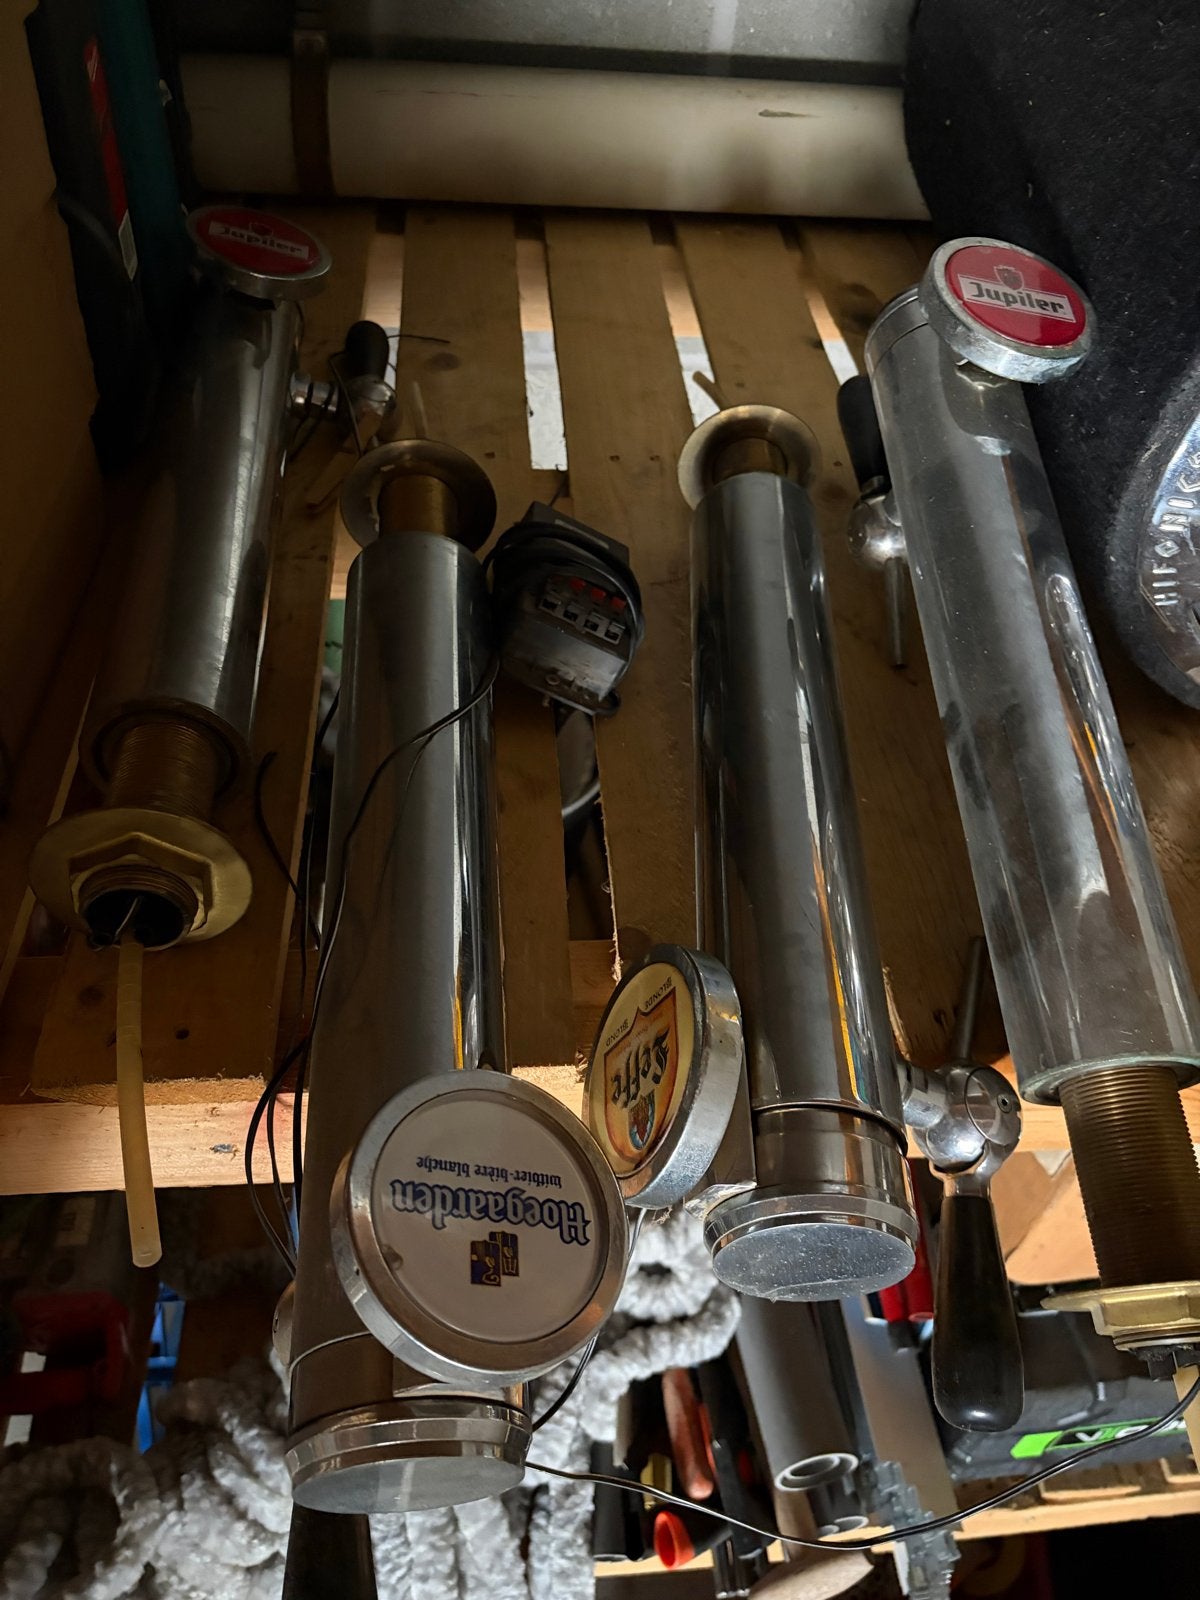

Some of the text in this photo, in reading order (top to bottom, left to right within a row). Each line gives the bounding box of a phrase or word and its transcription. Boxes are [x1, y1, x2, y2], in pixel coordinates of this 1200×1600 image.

[219, 226, 303, 253] Jupiler
[970, 281, 1065, 314] Jupiler
[644, 976, 673, 1010] BLONDE
[605, 1018, 629, 1047] BLOND
[610, 1026, 671, 1109] Leffe
[416, 1156, 470, 1178] blanche
[389, 1178, 592, 1246] Hoegaarden
